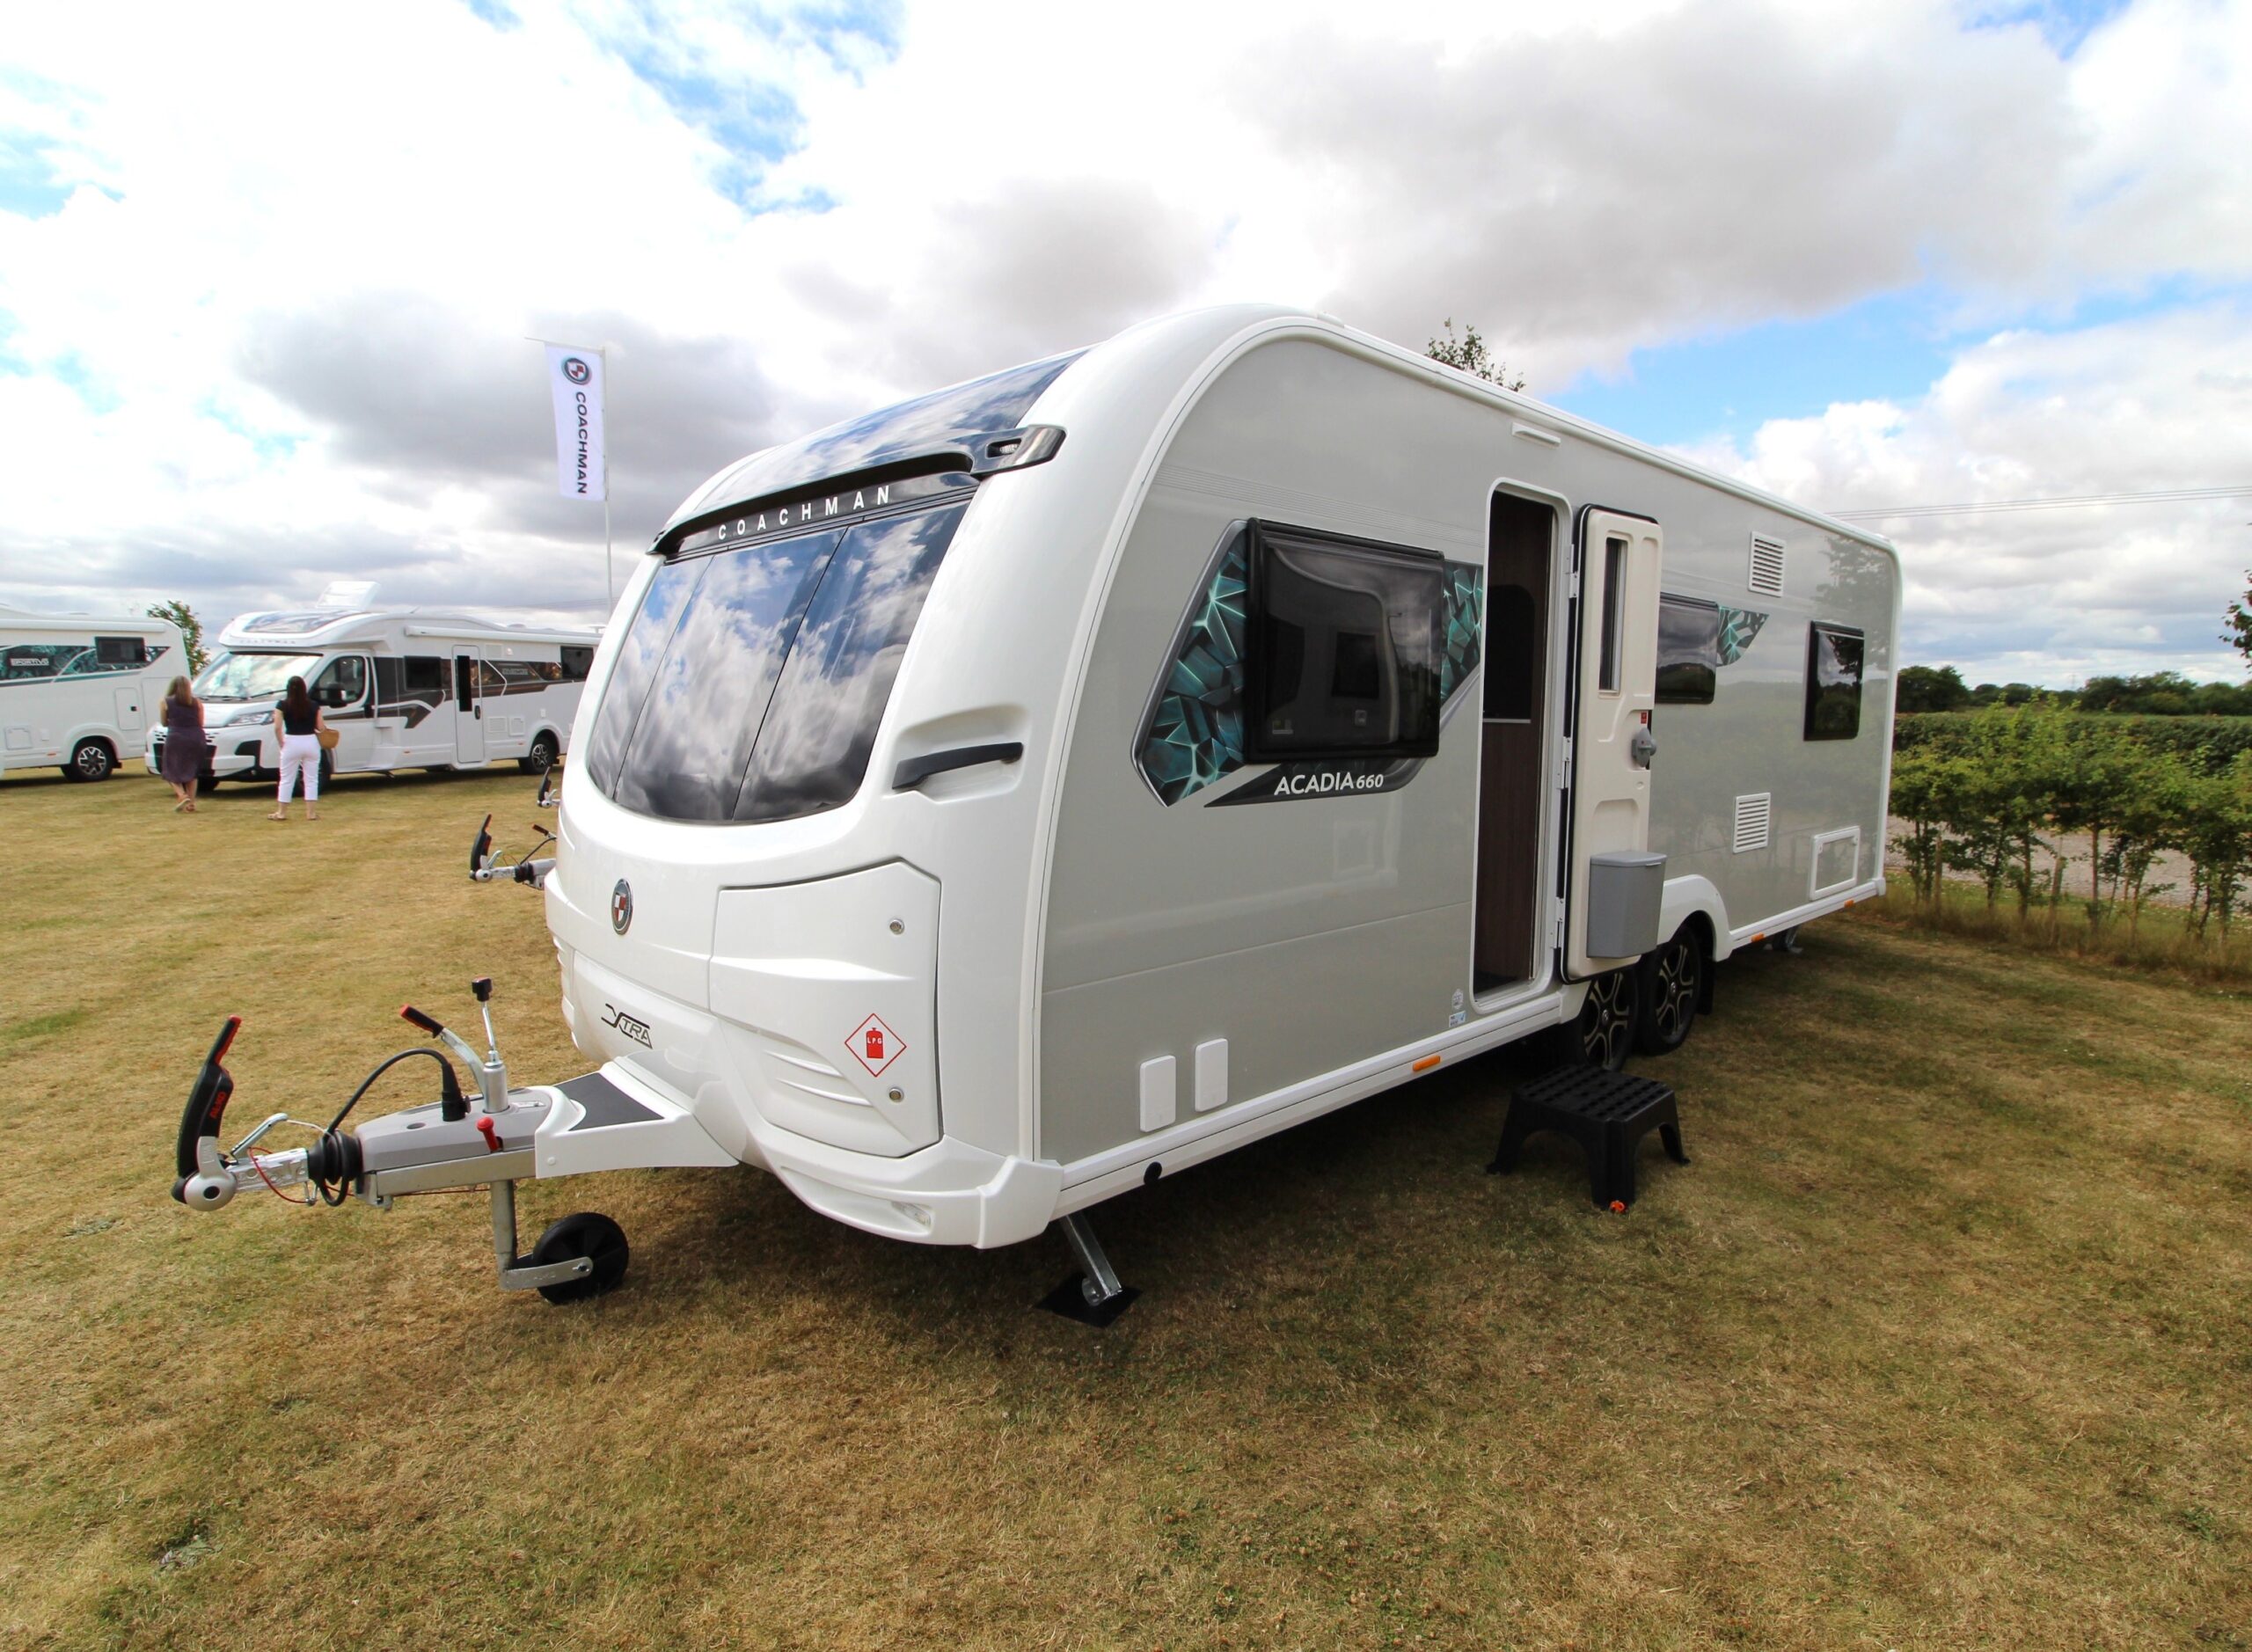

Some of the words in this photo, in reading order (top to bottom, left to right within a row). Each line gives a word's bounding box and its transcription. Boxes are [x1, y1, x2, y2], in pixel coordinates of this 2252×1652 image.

[575, 391, 588, 493] COACHMAN
[718, 486, 889, 540] COACHMAN
[1274, 771, 1354, 795] ACADIA
[1356, 774, 1384, 789] 660
